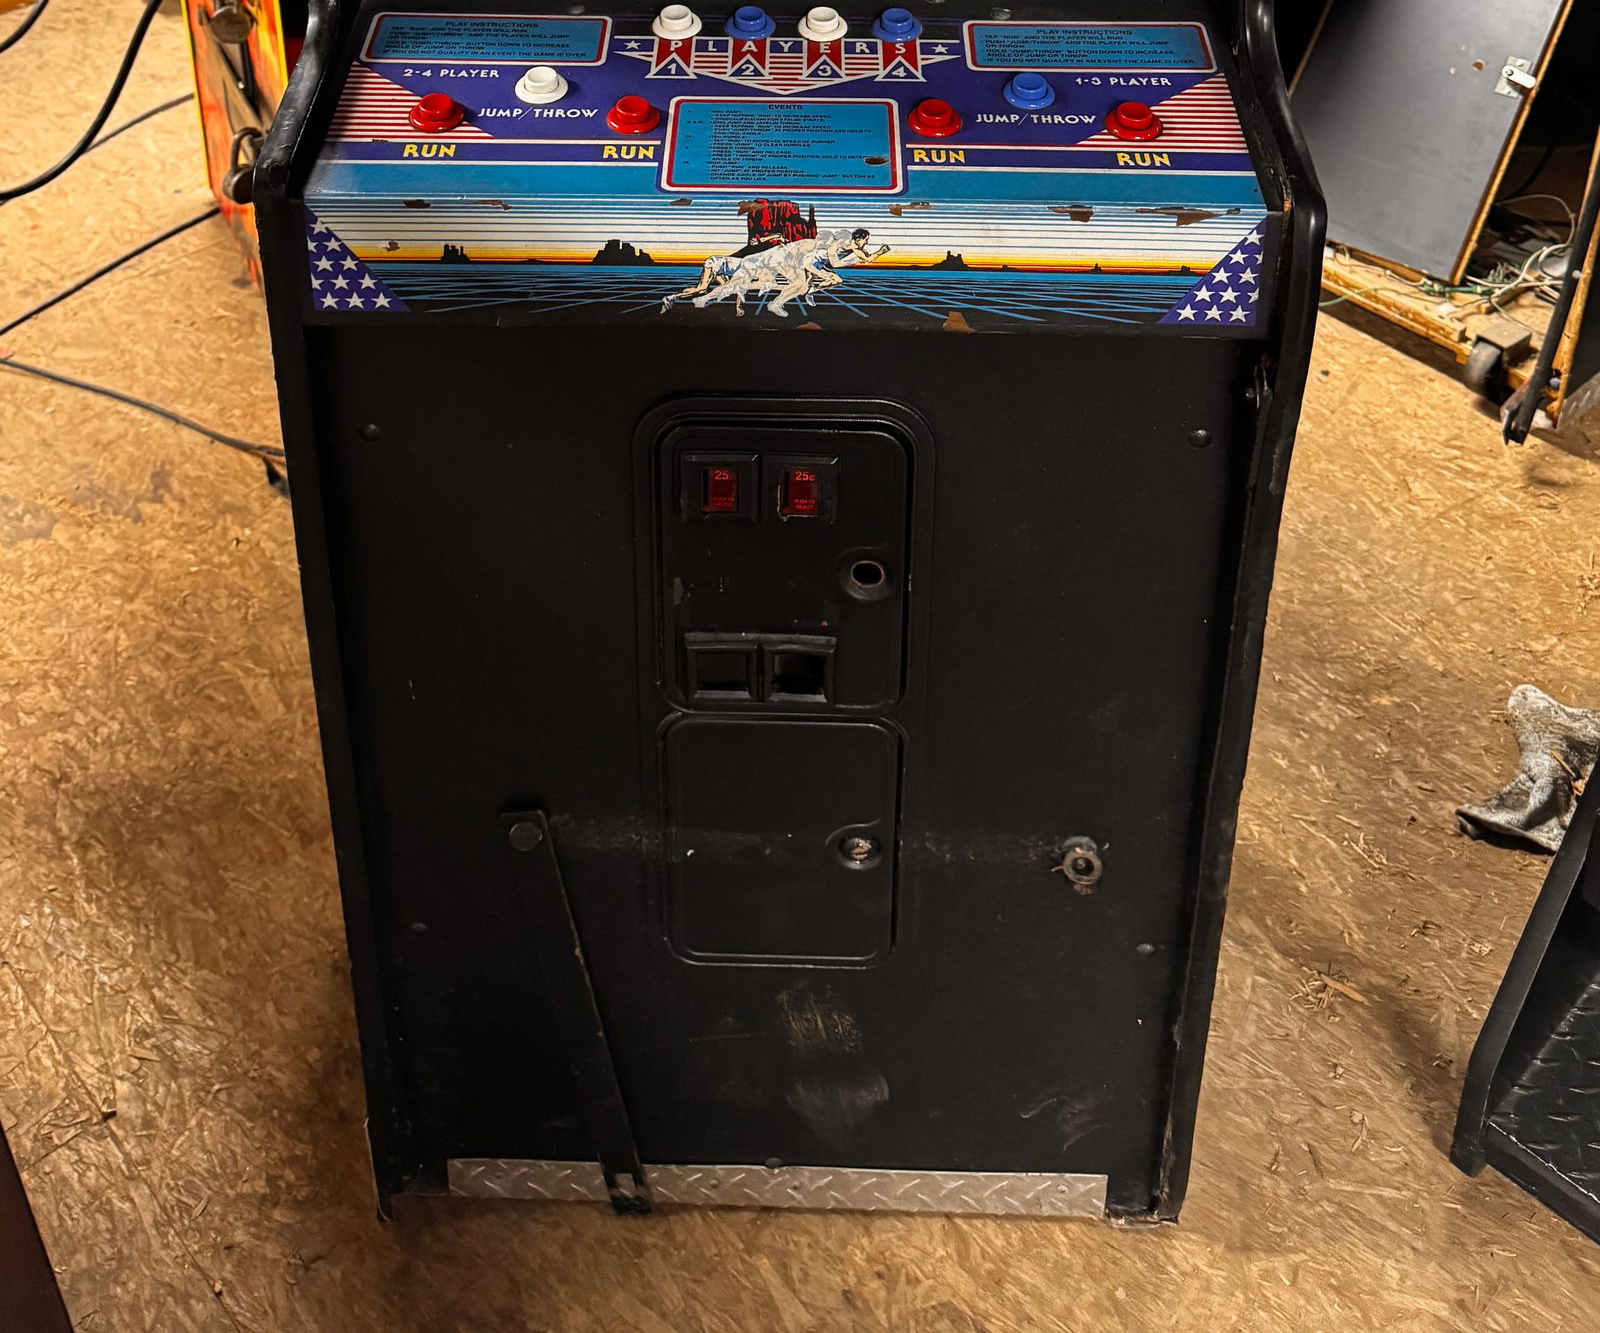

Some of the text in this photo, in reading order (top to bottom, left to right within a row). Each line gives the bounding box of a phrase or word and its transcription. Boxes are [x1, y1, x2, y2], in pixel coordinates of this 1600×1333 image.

[403, 68, 500, 79] 2-4 PLAYER
[667, 64, 677, 75] 1
[741, 64, 755, 76] 2
[817, 64, 831, 76] 3
[892, 65, 907, 78] 4
[1109, 76, 1172, 87] PLAYER
[477, 106, 599, 120] JUMP/THROW
[976, 113, 1096, 126] JUMP/THROW
[402, 144, 457, 159] RUN
[602, 145, 656, 160] RUN
[913, 149, 966, 165] RUN
[1116, 152, 1172, 168] RUN
